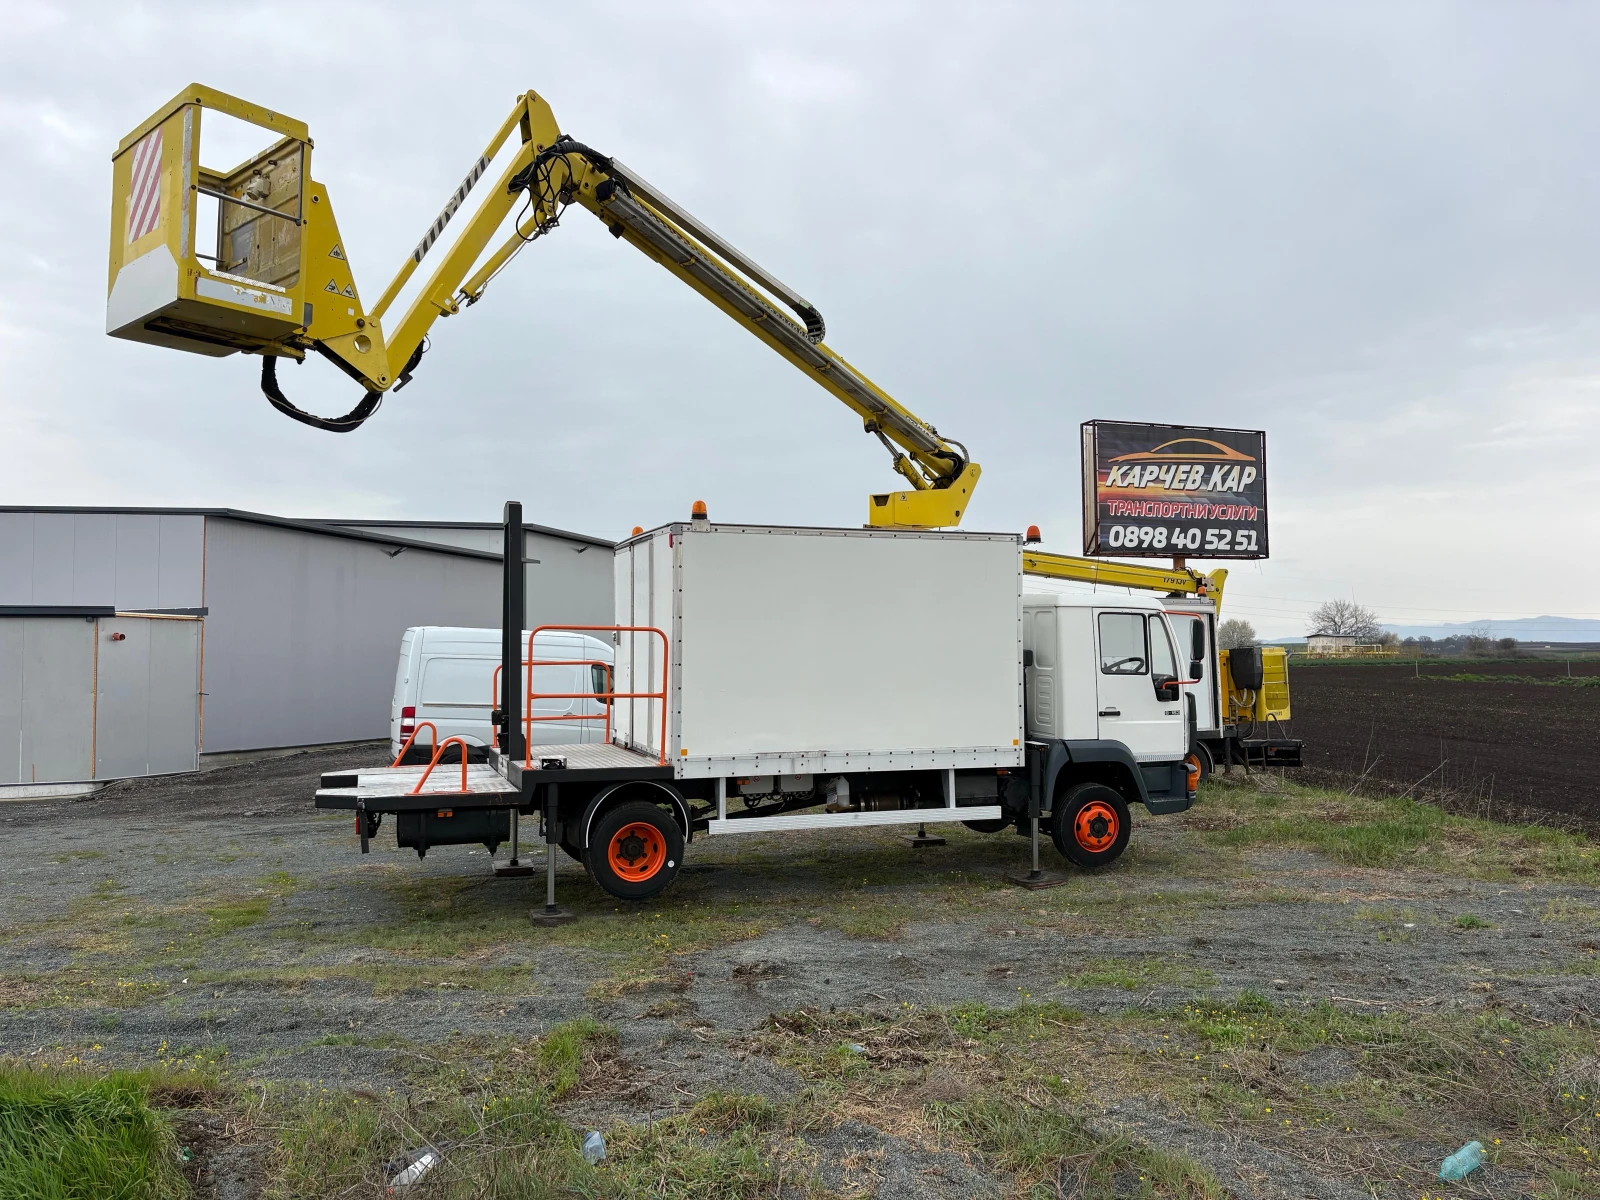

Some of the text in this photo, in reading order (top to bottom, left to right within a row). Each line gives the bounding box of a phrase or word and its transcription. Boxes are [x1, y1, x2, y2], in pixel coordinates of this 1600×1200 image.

[1105, 465, 1257, 493] КАРЧЕВ КАР
[1107, 500, 1258, 521] ТРАНСПОРТНИ УСЛУГИ
[1108, 525, 1259, 551] 0898 40 52 51
